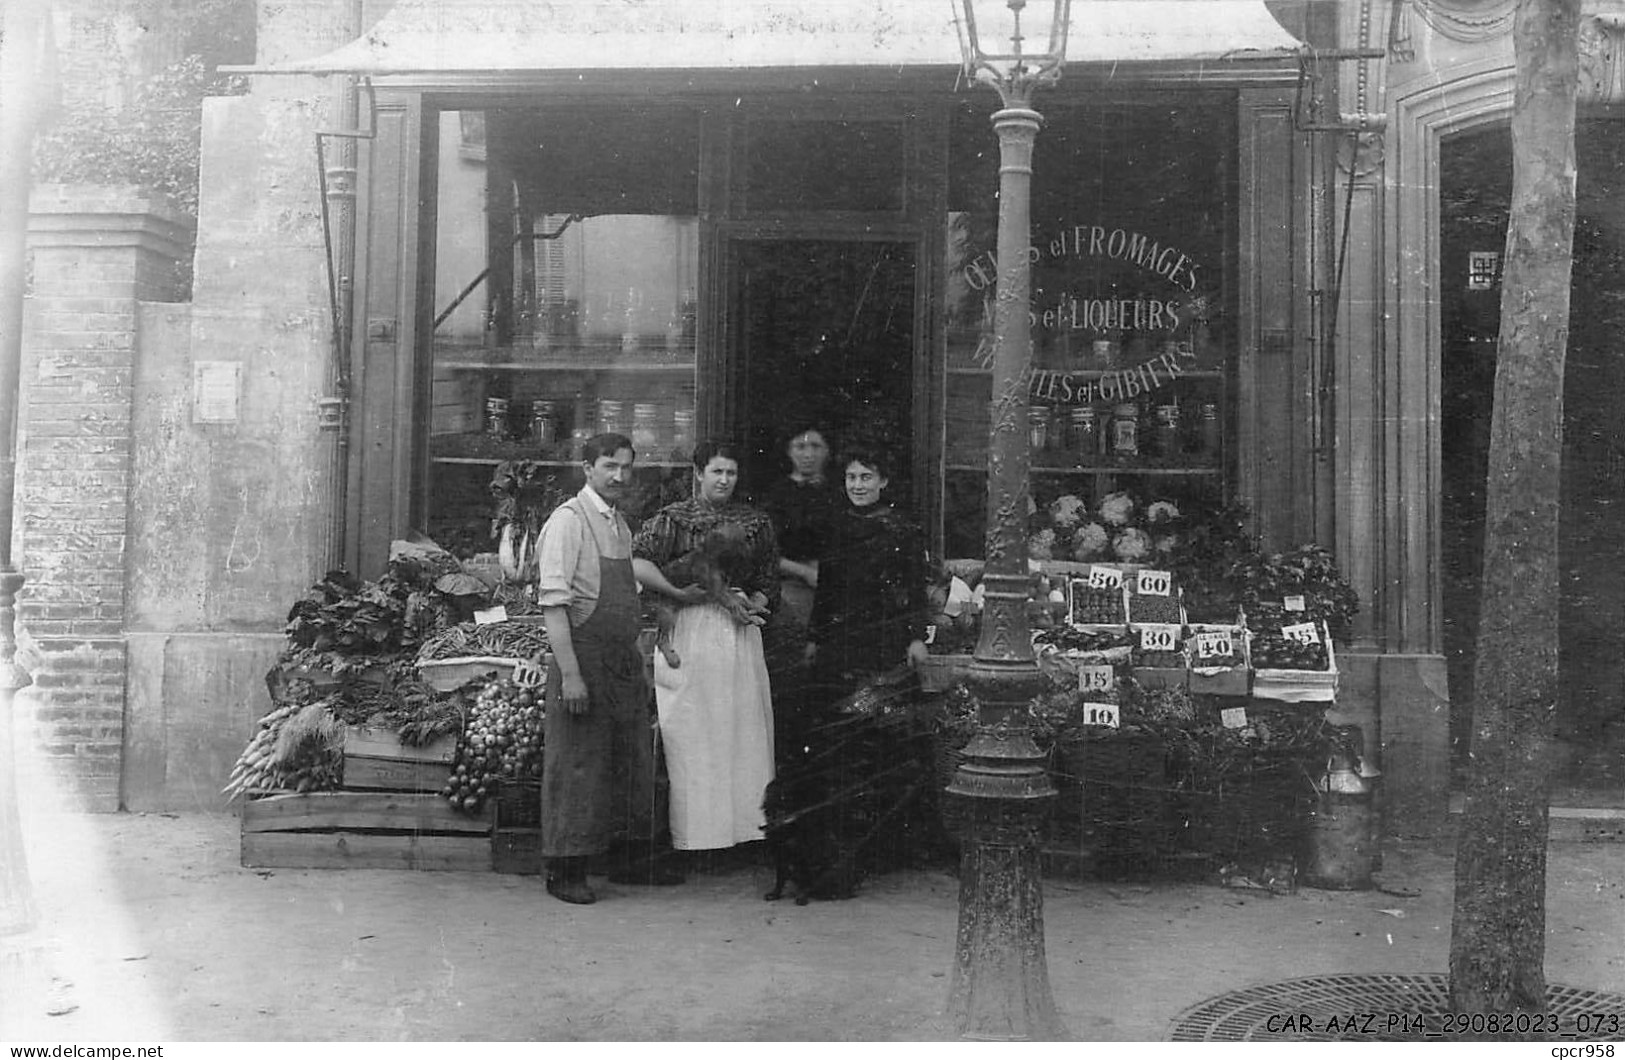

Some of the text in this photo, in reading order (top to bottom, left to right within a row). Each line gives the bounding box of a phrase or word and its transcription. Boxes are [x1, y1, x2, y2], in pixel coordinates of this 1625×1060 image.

[1074, 225, 1201, 293] FROMAGES
[1071, 299, 1180, 333] LIQUEURS
[1091, 572, 1118, 587] 50
[1141, 576, 1167, 594] 60
[1145, 631, 1171, 647] 30
[1202, 640, 1230, 655] 40
[518, 668, 541, 685] 10
[1083, 671, 1107, 688] 15
[1090, 709, 1113, 724] 10
